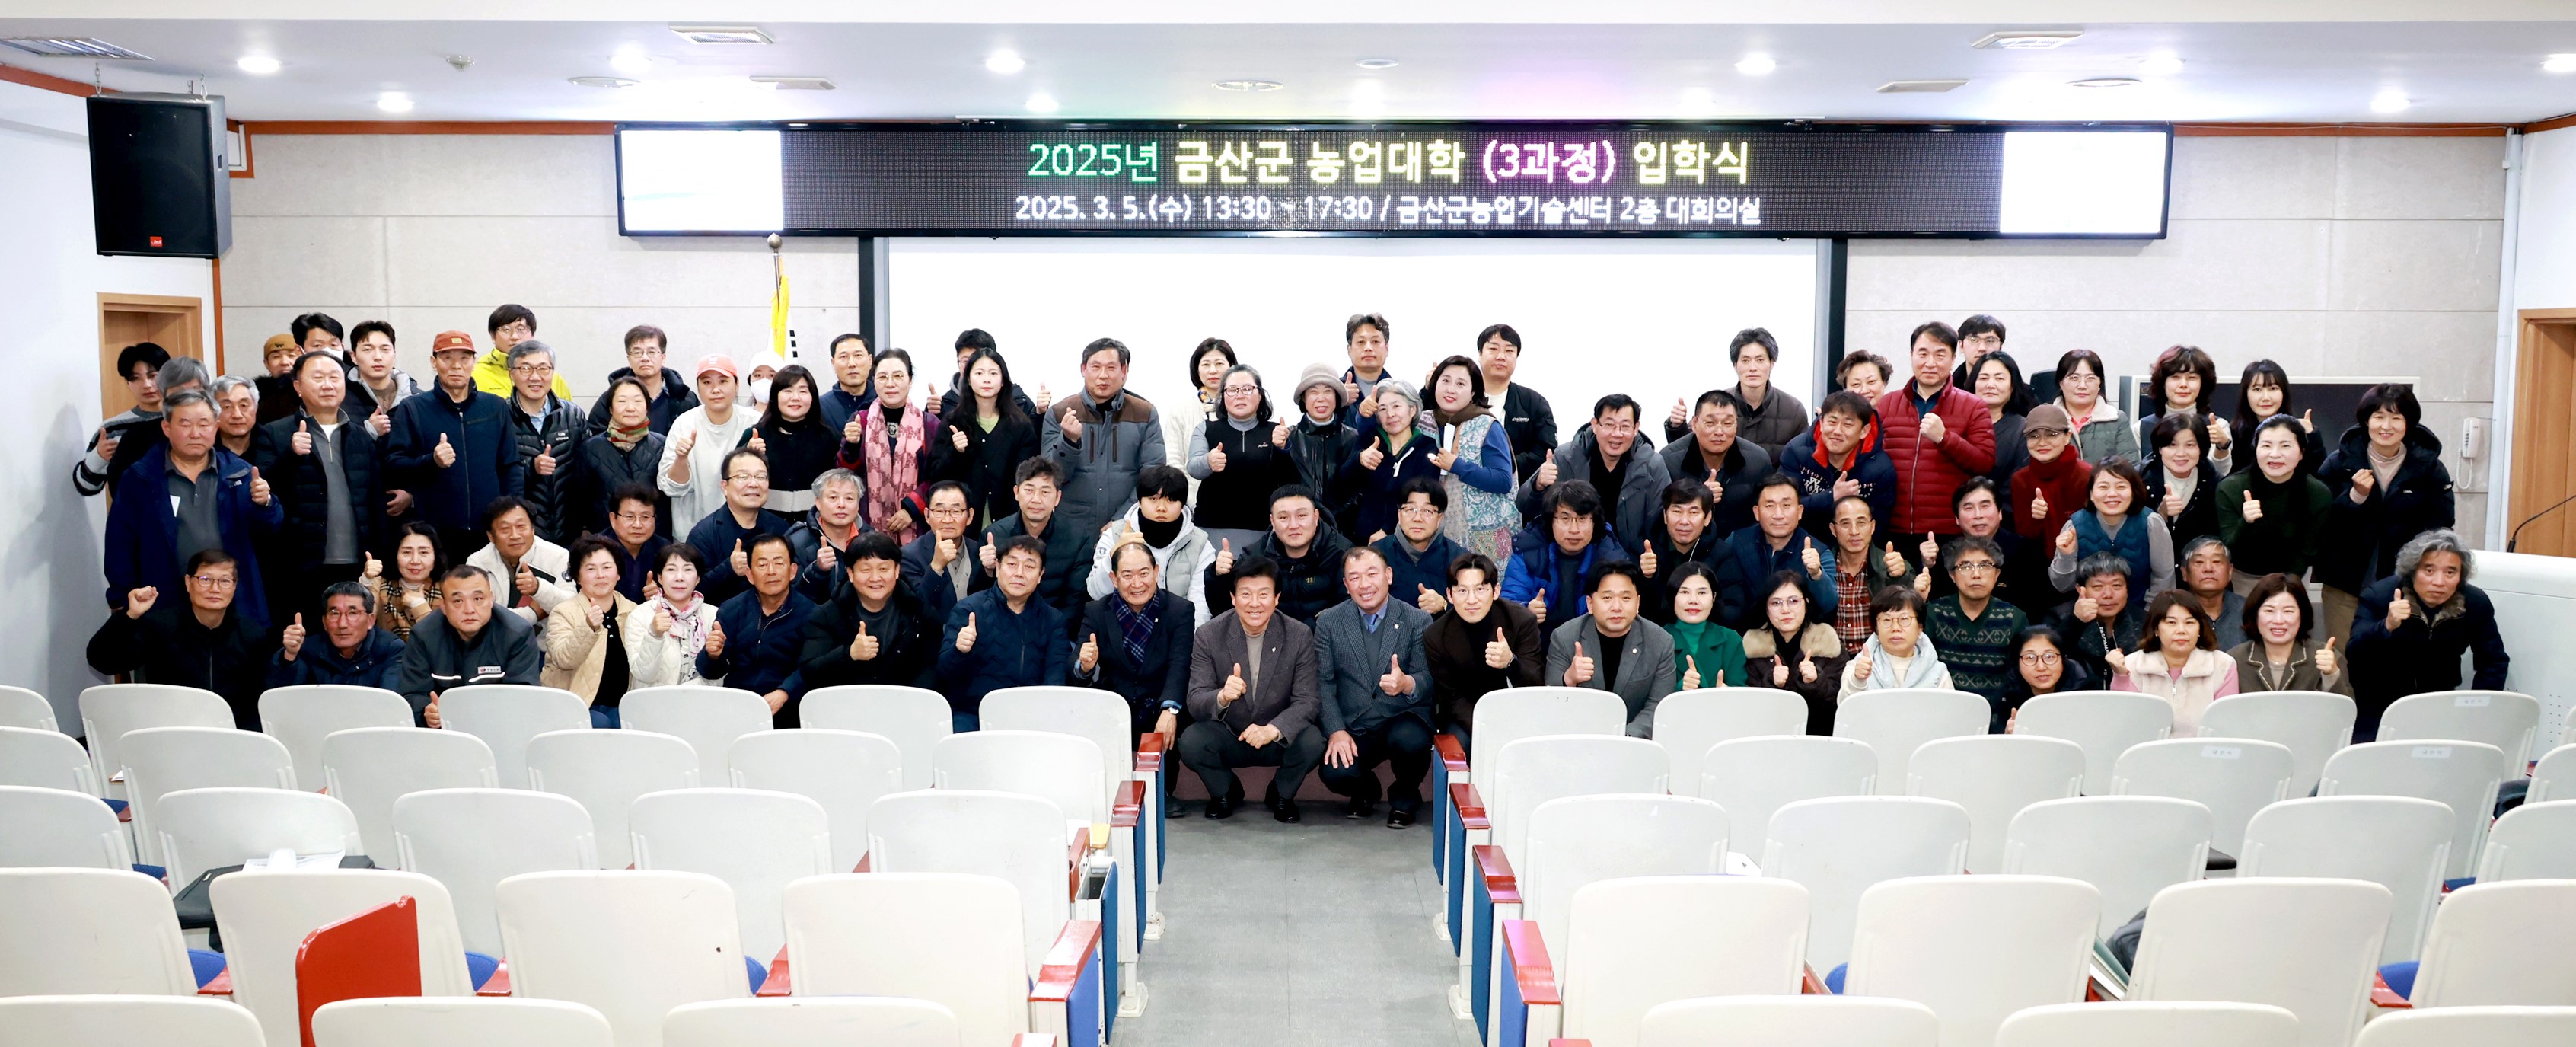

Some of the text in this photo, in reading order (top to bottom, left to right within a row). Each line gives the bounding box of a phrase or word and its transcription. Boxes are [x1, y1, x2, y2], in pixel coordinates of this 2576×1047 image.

[1028, 139, 1749, 184] 2025년 금산군 농업대학 (3과정) 입학식
[1015, 196, 1086, 219] 2025.
[1093, 196, 1116, 219] 3.
[1203, 196, 1272, 219] 13:30
[1304, 196, 1373, 219] 17:30
[1380, 194, 1391, 222] /
[1396, 196, 1612, 225] 금산군농업기술센터
[1620, 196, 1661, 224] 2층
[1666, 196, 1761, 225] 대회의실
